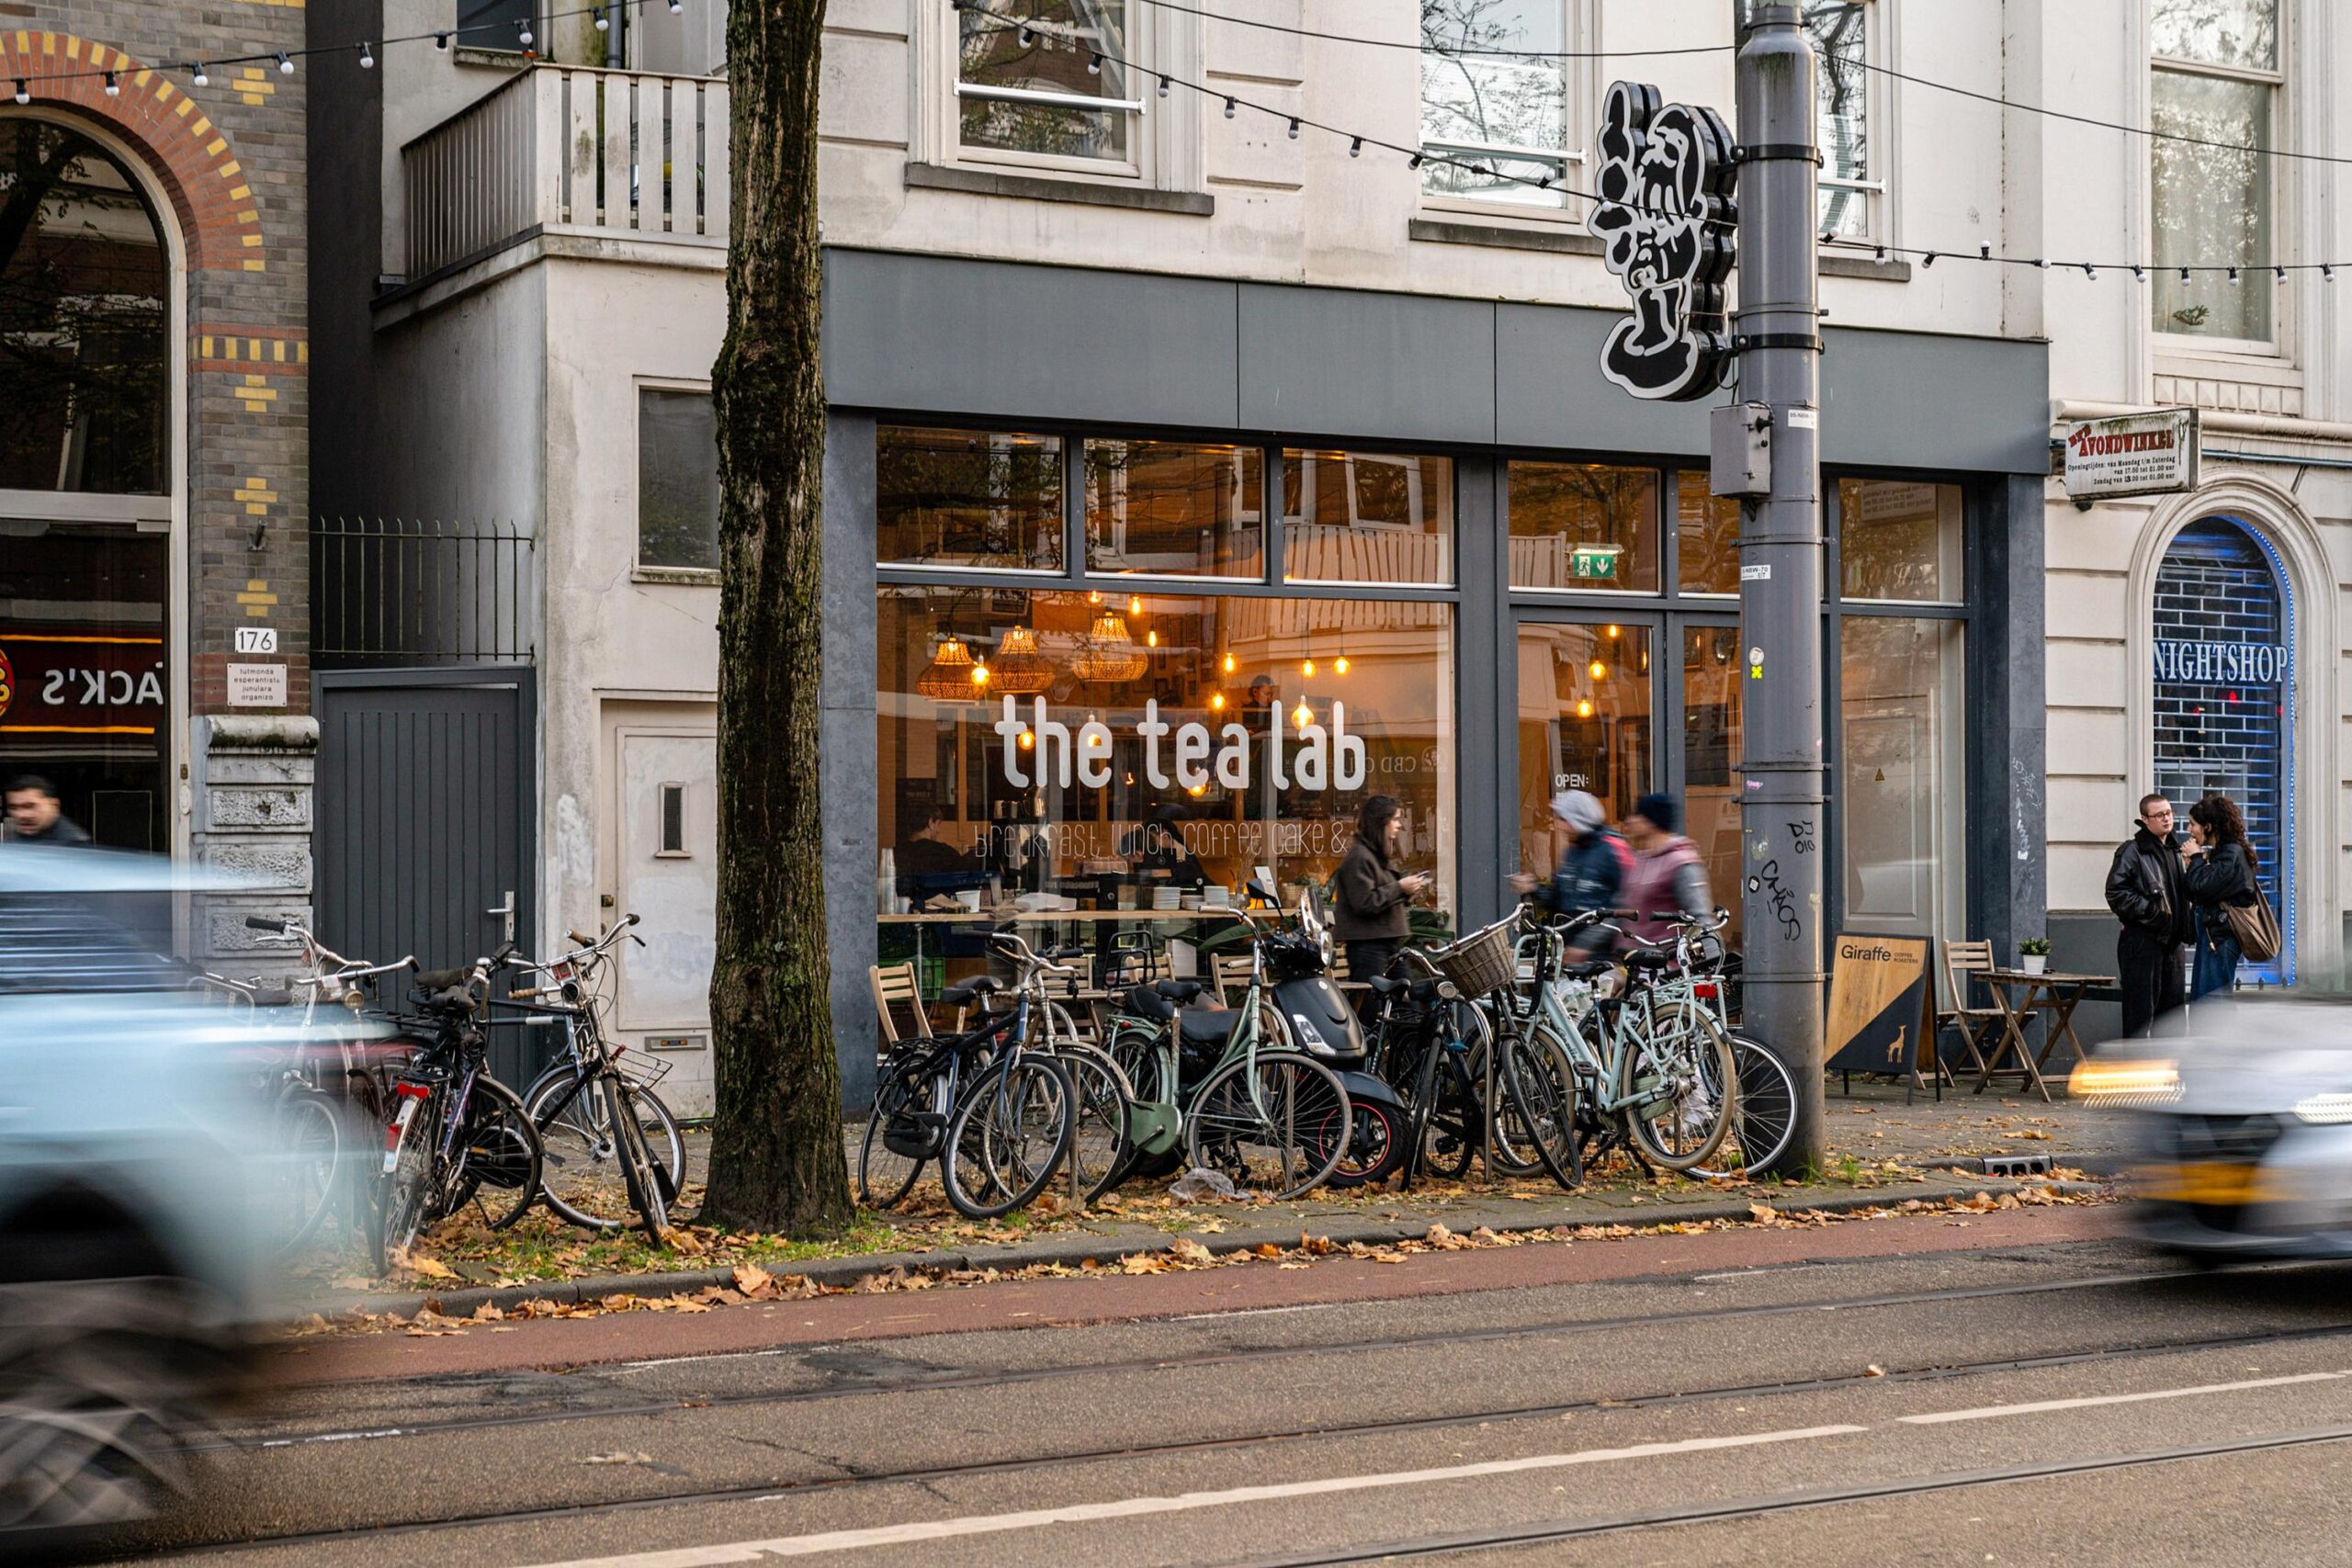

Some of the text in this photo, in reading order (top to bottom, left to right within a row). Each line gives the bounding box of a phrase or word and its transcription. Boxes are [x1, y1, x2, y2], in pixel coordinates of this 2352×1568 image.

[2079, 430, 2175, 457] AVONDWINKEL
[239, 631, 272, 650] 176
[2154, 642, 2288, 682] NIGHTSHOP
[994, 694, 1366, 791] the tea lab
[1555, 773, 1589, 787] OPEN:
[975, 821, 1348, 858] breakfast lunch coffee cake &
[1840, 944, 1892, 962] Giraffe
